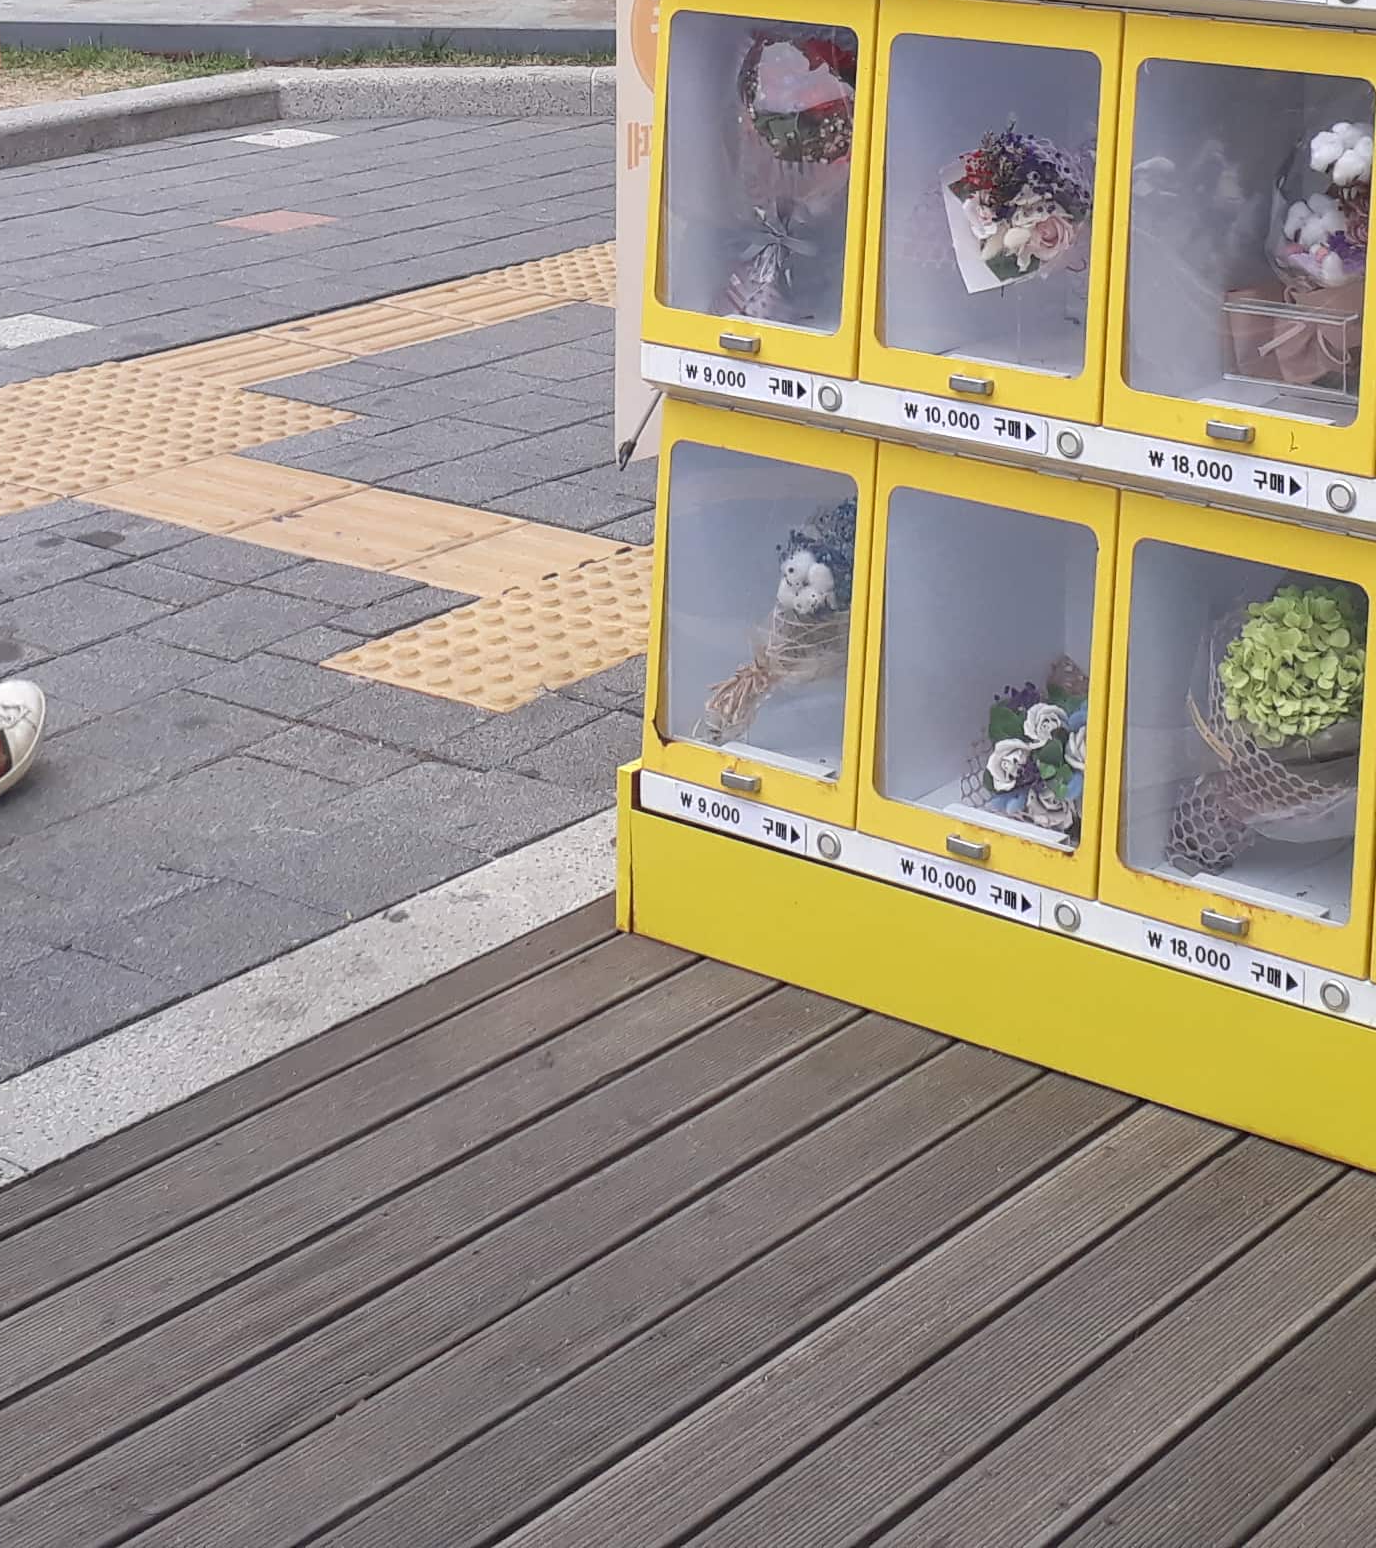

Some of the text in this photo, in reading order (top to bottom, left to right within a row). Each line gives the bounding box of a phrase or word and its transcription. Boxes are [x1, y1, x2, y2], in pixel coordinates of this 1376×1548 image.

[687, 365, 792, 397] ₩ 9,000 구매
[905, 403, 1020, 439] ₩ 10,000 구매
[1149, 451, 1284, 493] ₩ 18,000 구매
[681, 793, 786, 840] ₩ 9,000 구매
[901, 859, 1016, 909] ₩ 10,000 구매
[1148, 931, 1281, 988] ₩ 18,000 구매
